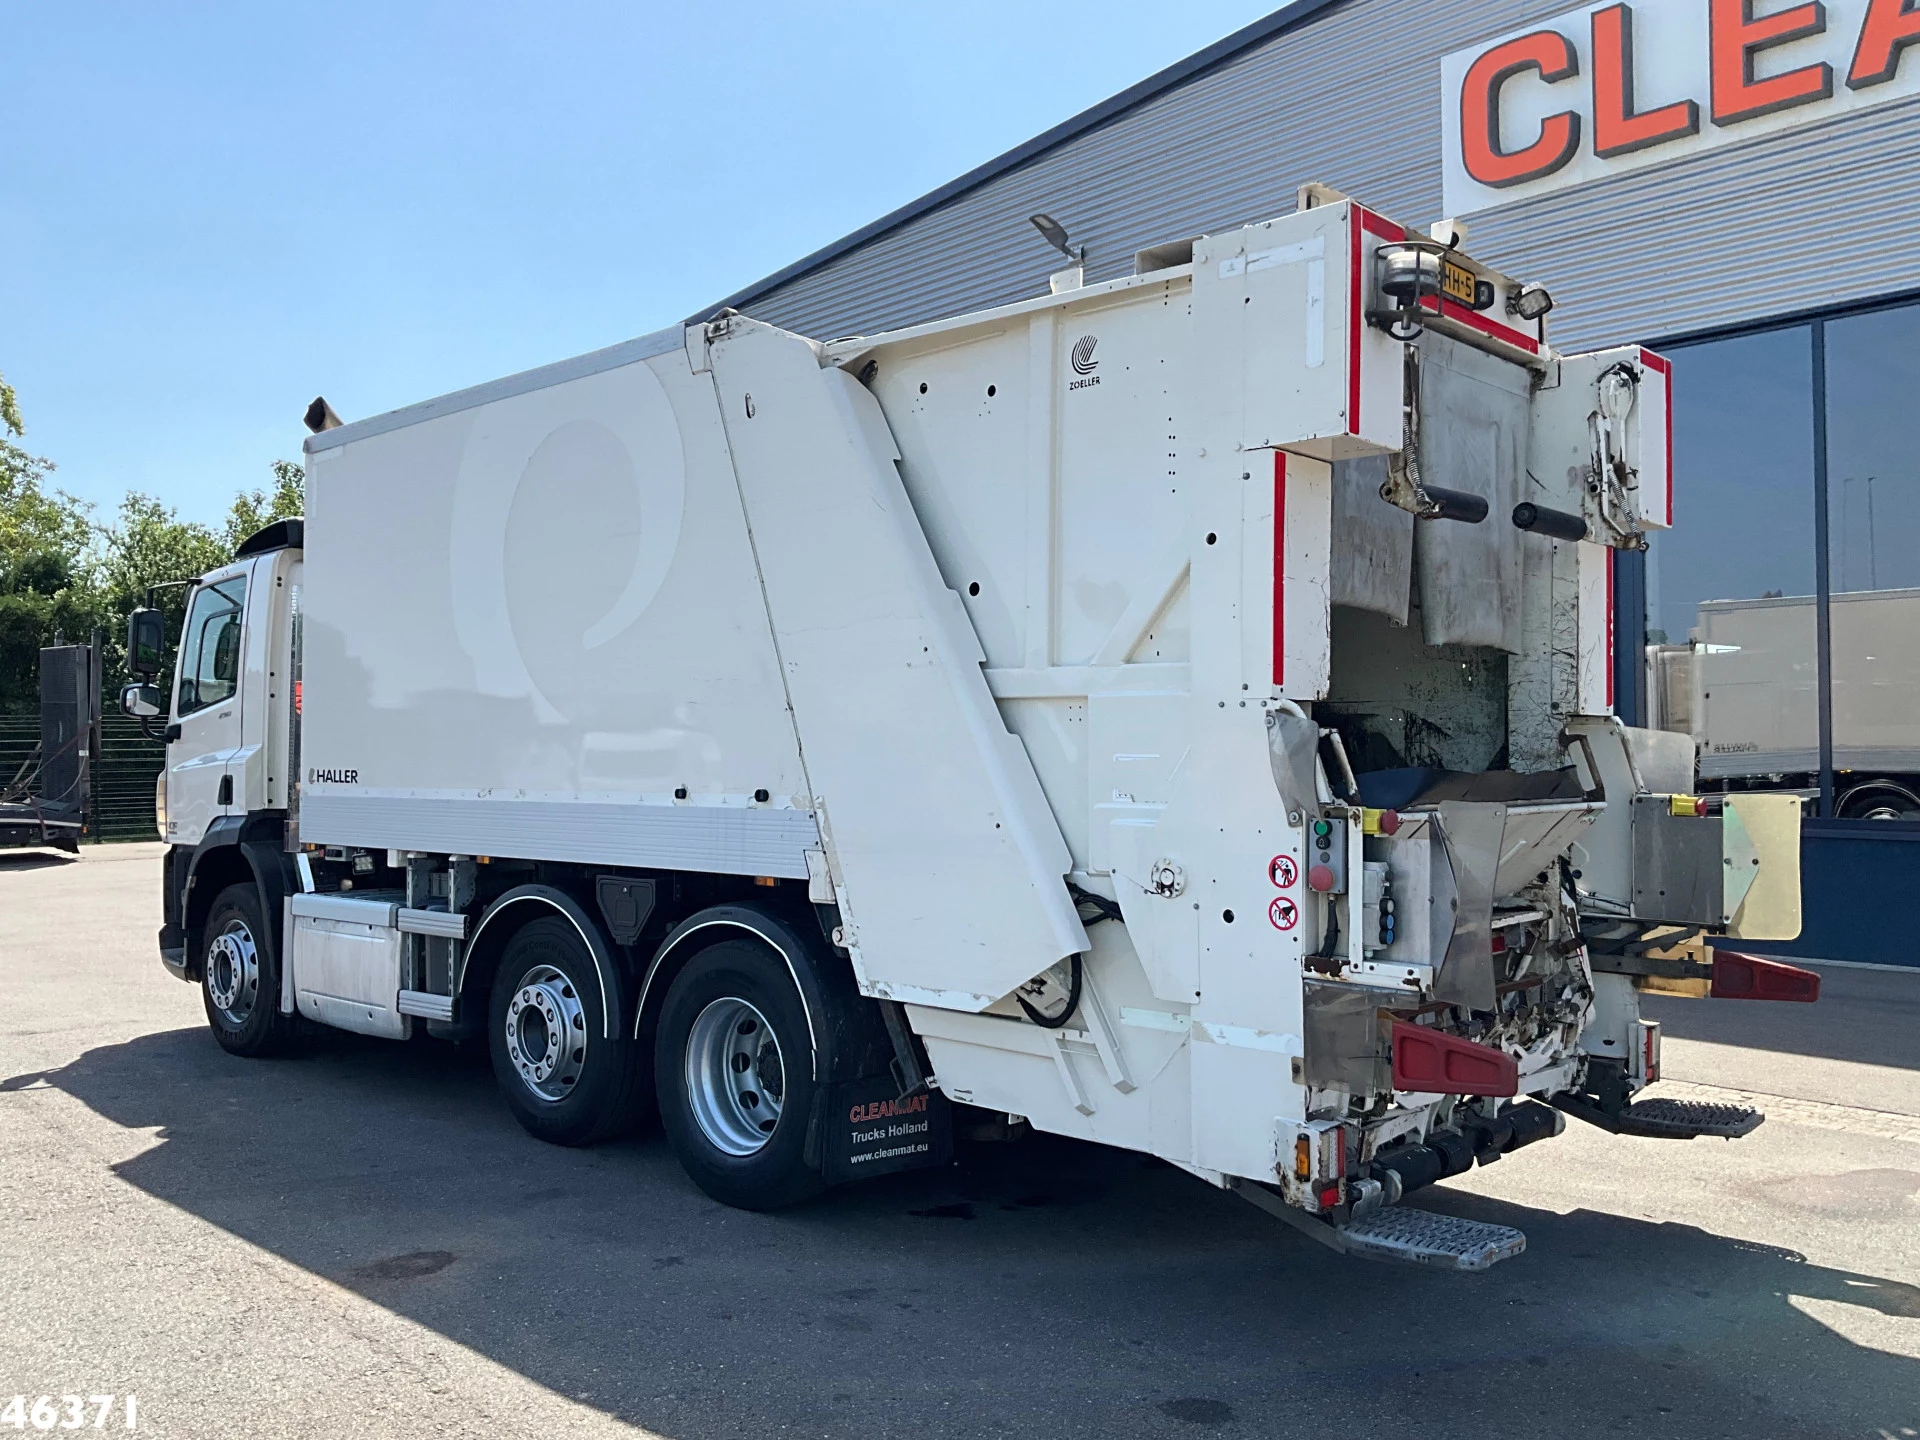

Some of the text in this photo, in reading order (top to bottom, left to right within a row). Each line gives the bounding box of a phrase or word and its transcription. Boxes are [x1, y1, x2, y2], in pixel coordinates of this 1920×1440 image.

[1069, 376, 1101, 391] ZOELLER
[316, 769, 358, 784] HALLER
[851, 1120, 928, 1144] Trucks Holland
[850, 1143, 929, 1164] www.cleanmat.eu
